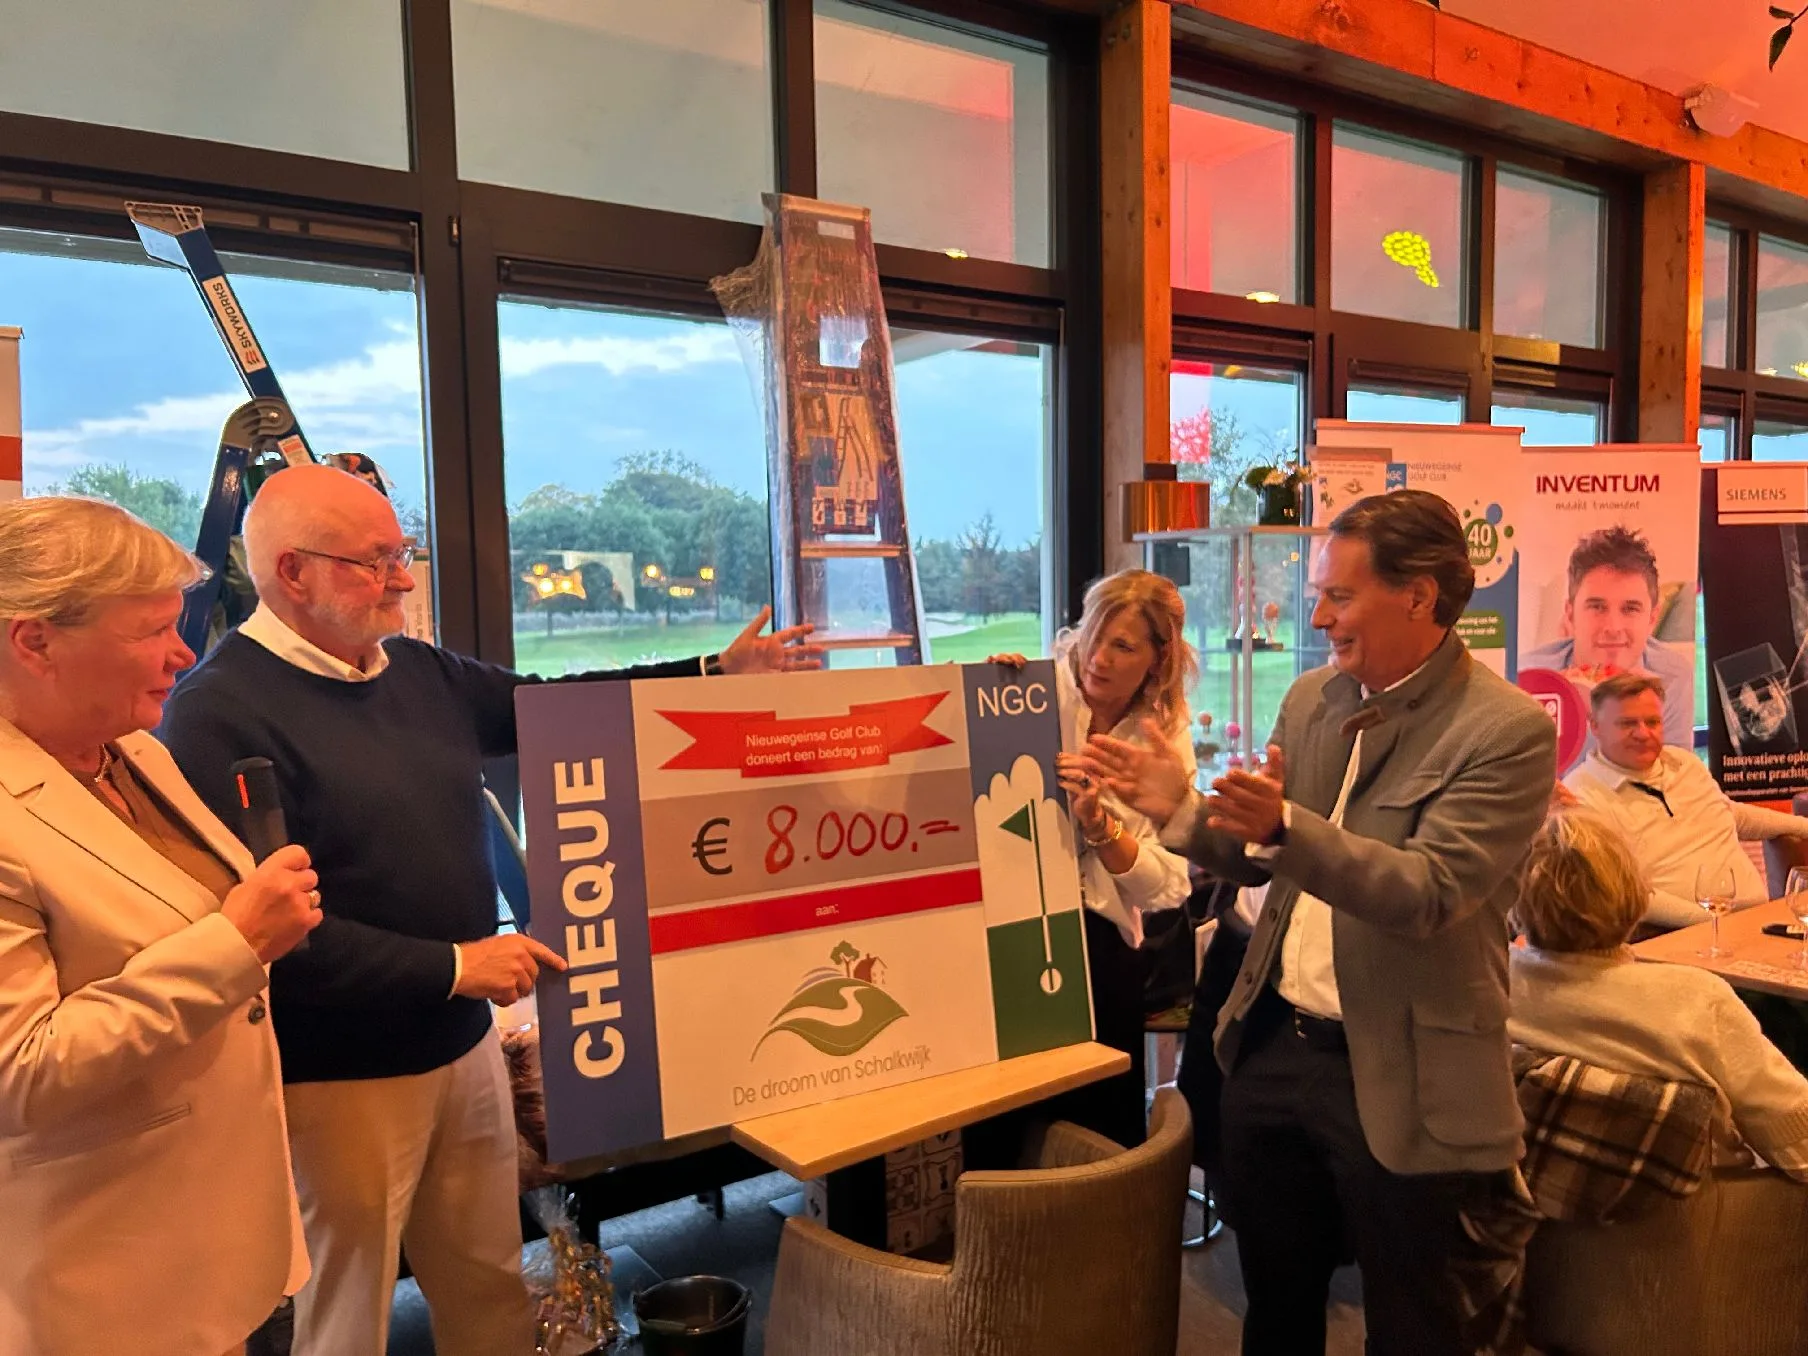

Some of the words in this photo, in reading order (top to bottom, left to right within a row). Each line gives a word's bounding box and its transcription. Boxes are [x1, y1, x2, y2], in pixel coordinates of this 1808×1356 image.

[213, 282, 252, 349] SKYWORKS
[1536, 474, 1660, 493] INVENTUM
[1726, 488, 1787, 501] SIEMENS
[1467, 523, 1492, 547] 40
[976, 682, 1049, 719] NGC
[745, 730, 827, 747] Nieuwegeinse
[829, 726, 853, 741] Golf
[855, 725, 881, 739] Club
[746, 751, 791, 766] doneert
[794, 750, 815, 762] een
[818, 746, 857, 760] bedrag
[1723, 752, 1786, 767] Innovatieve
[1723, 770, 1744, 782] met
[1746, 770, 1767, 782] een
[691, 816, 733, 876] €
[554, 757, 626, 1079] CHEQUE
[733, 1086, 757, 1106] De
[760, 1073, 818, 1100] droom
[820, 1066, 851, 1086] van
[855, 1044, 931, 1078] Schalkwijk
